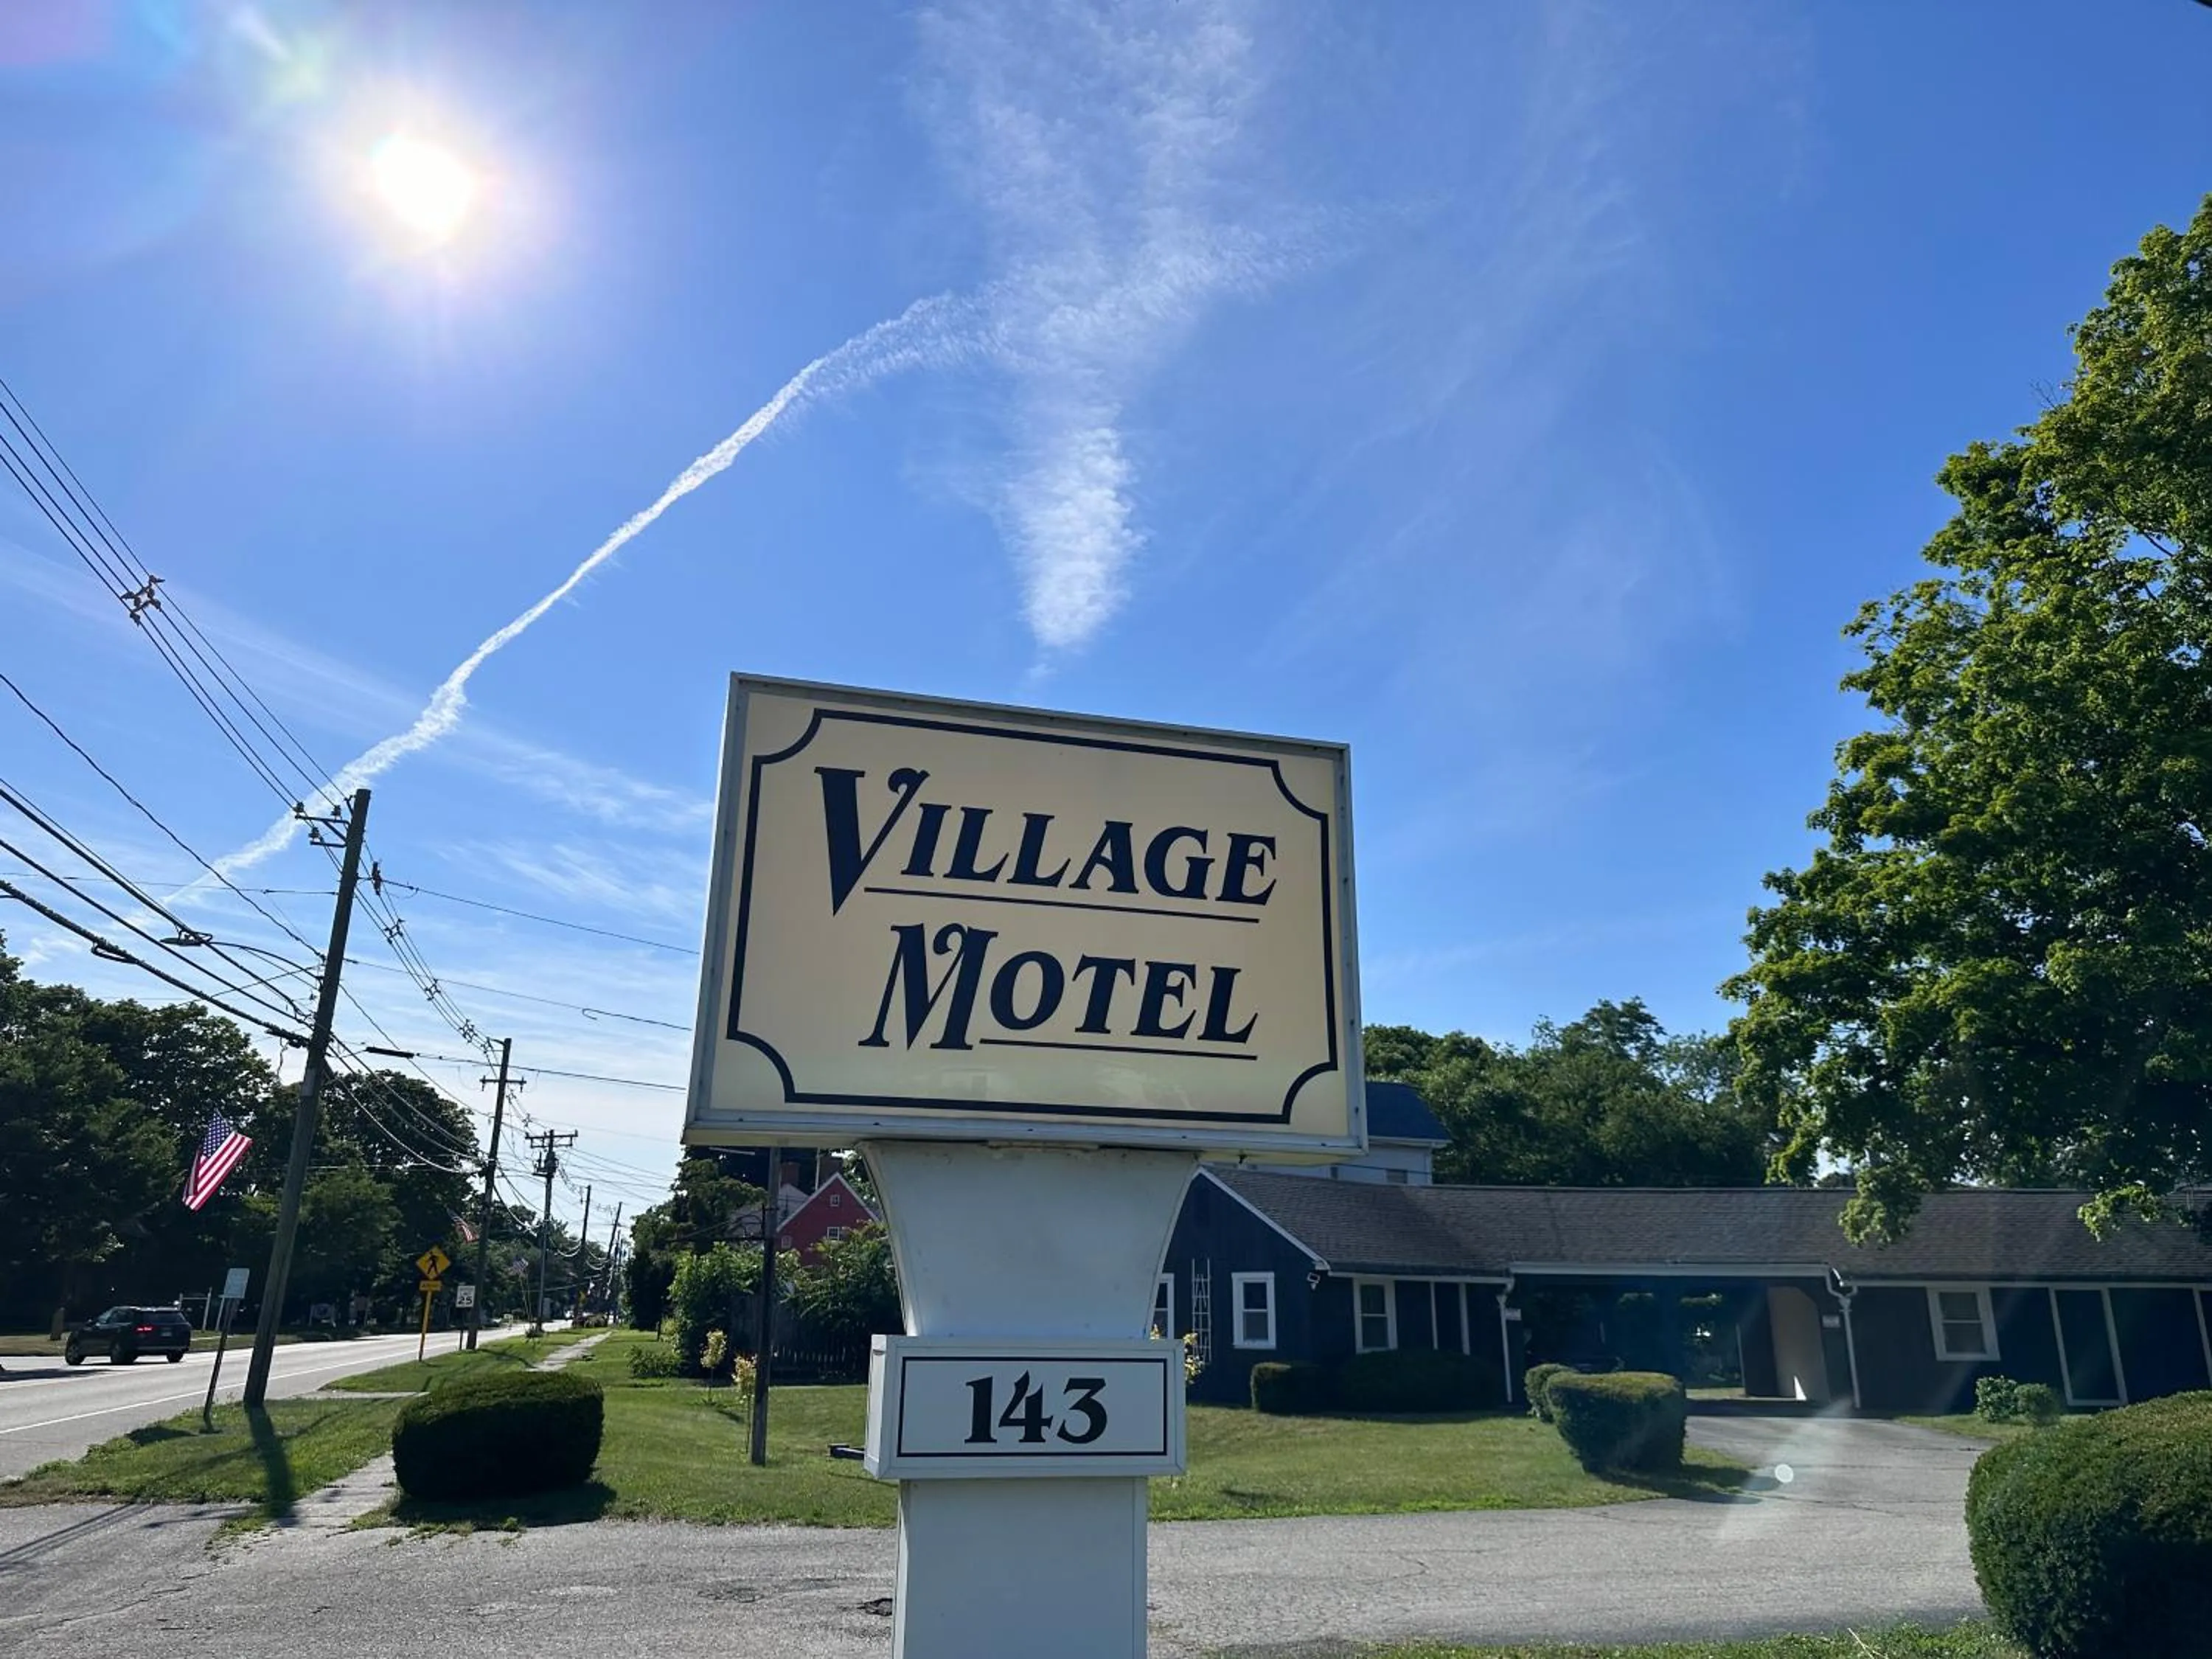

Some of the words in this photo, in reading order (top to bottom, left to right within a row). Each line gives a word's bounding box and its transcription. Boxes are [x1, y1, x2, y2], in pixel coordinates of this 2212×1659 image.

[813, 765, 1277, 917] VILLAGE
[858, 922, 1259, 1051] MOTEL
[458, 1296, 473, 1305] 25
[964, 1370, 1107, 1444] 143
